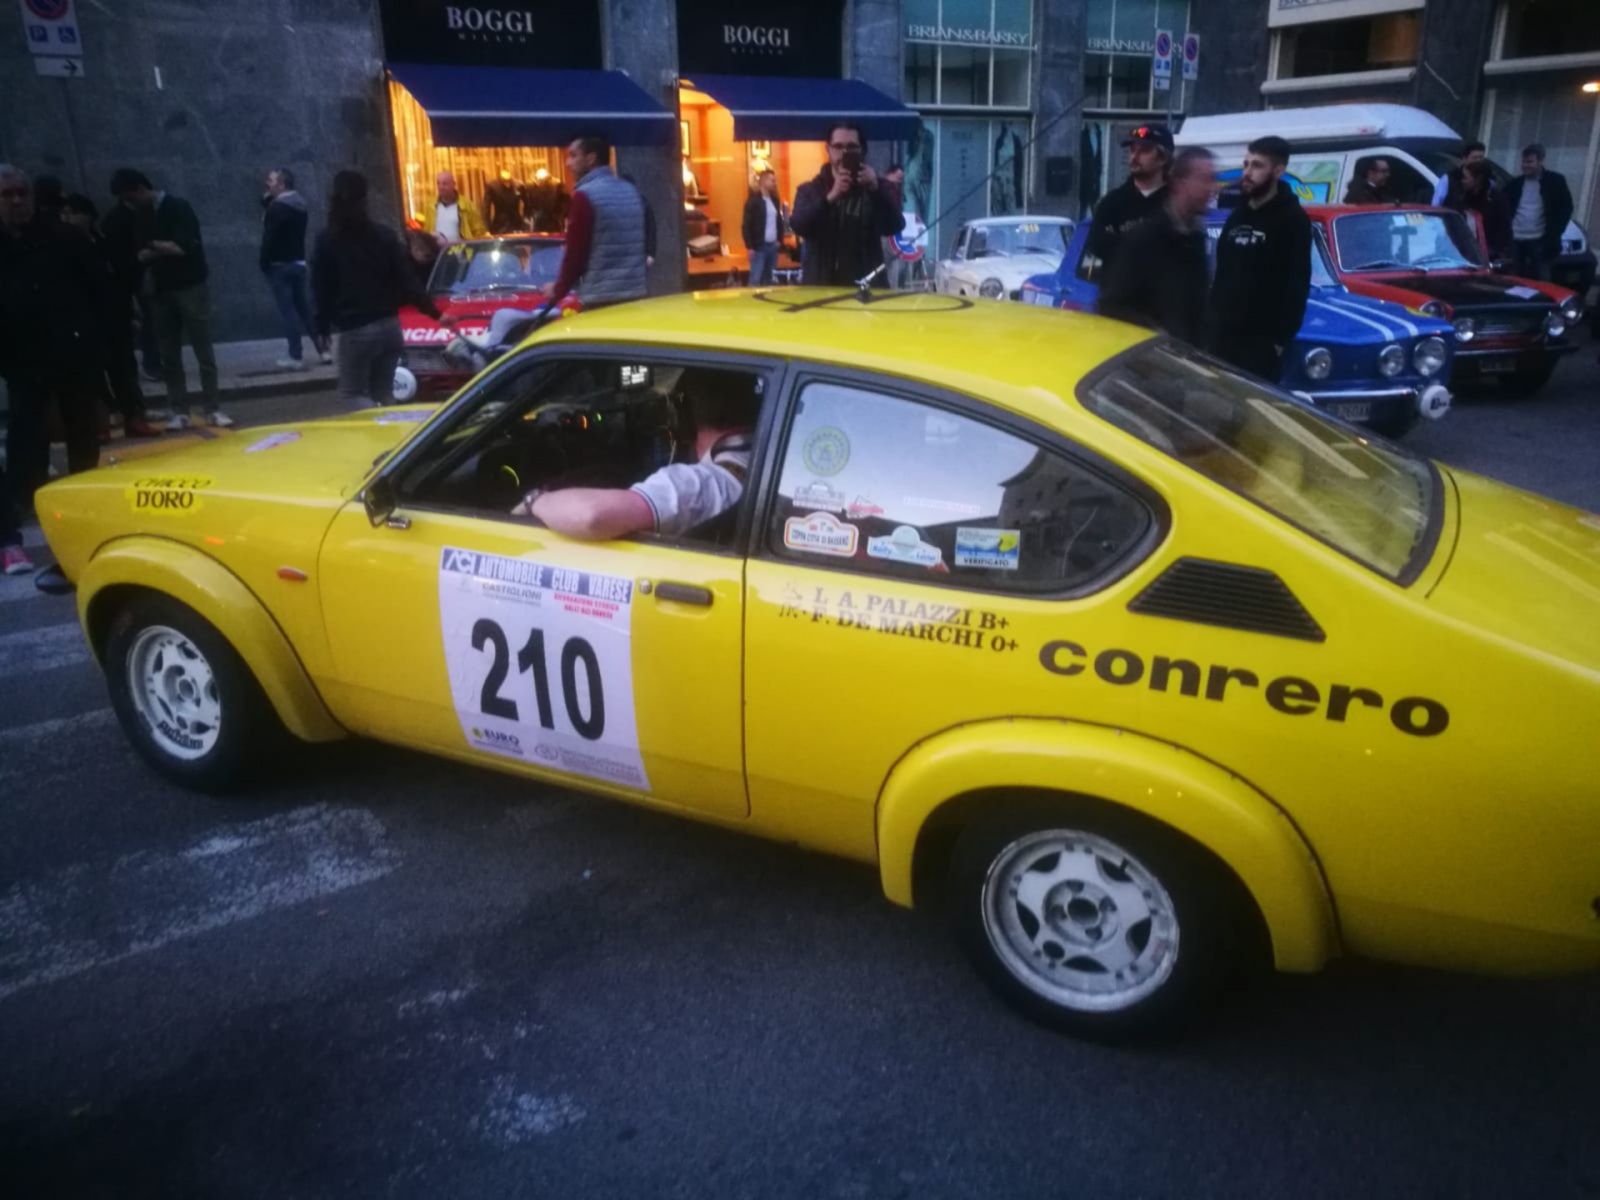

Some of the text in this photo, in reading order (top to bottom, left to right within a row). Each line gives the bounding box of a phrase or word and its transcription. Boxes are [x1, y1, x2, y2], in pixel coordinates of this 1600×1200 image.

[446, 6, 534, 33] BOGGI
[723, 24, 790, 47] BOGGI
[907, 24, 1029, 45] BRIAN&BARRY
[963, 557, 1010, 567] VERIFICATO
[478, 555, 544, 586] AUTOMOBILE
[551, 568, 580, 592] CLUB
[588, 575, 630, 602] VARESE
[482, 583, 542, 600] CASTIGLIONI
[866, 593, 974, 627] PALAZZI
[980, 610, 1010, 630] B+
[837, 609, 872, 631] DE
[877, 615, 986, 649] MARCHI
[471, 617, 606, 742] 210
[1038, 639, 1451, 738] conrero
